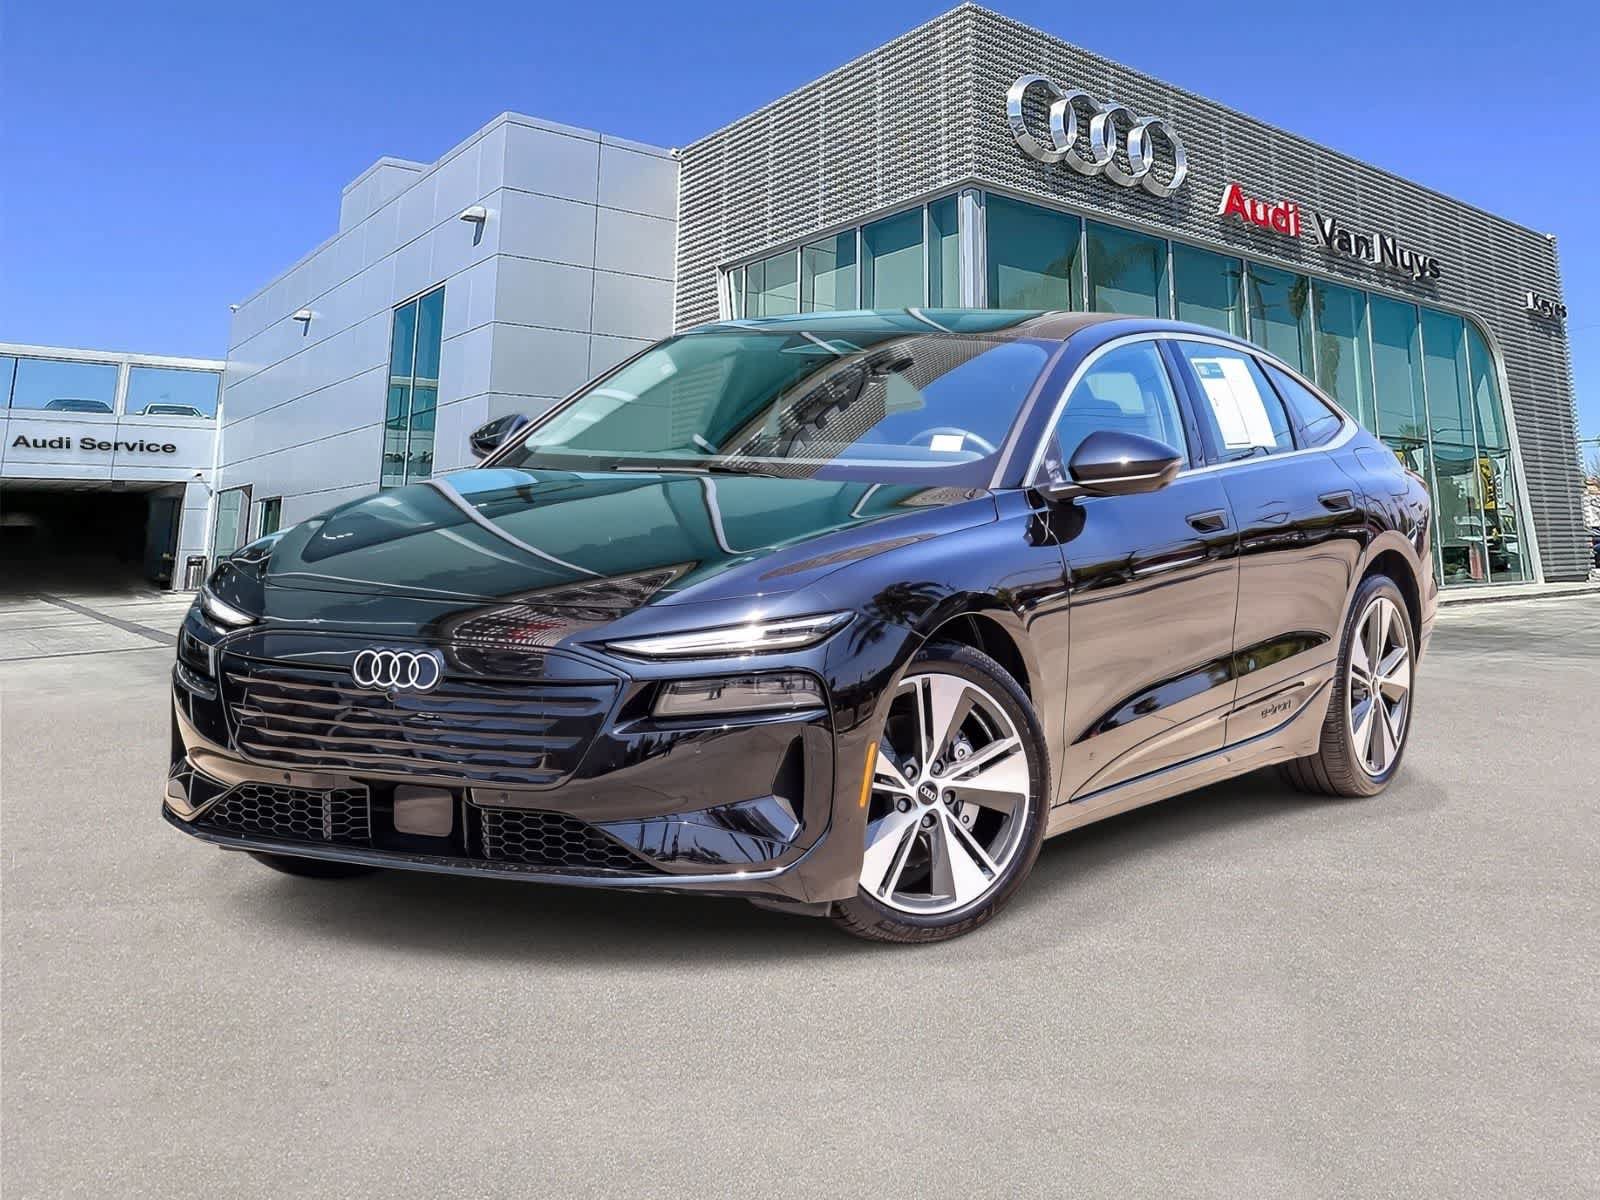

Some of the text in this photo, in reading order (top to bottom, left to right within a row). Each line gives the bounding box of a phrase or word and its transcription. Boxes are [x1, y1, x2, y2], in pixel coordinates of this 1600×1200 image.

[1217, 182, 1441, 281] Audi Van Nuys
[12, 435, 177, 454] Audi Service
